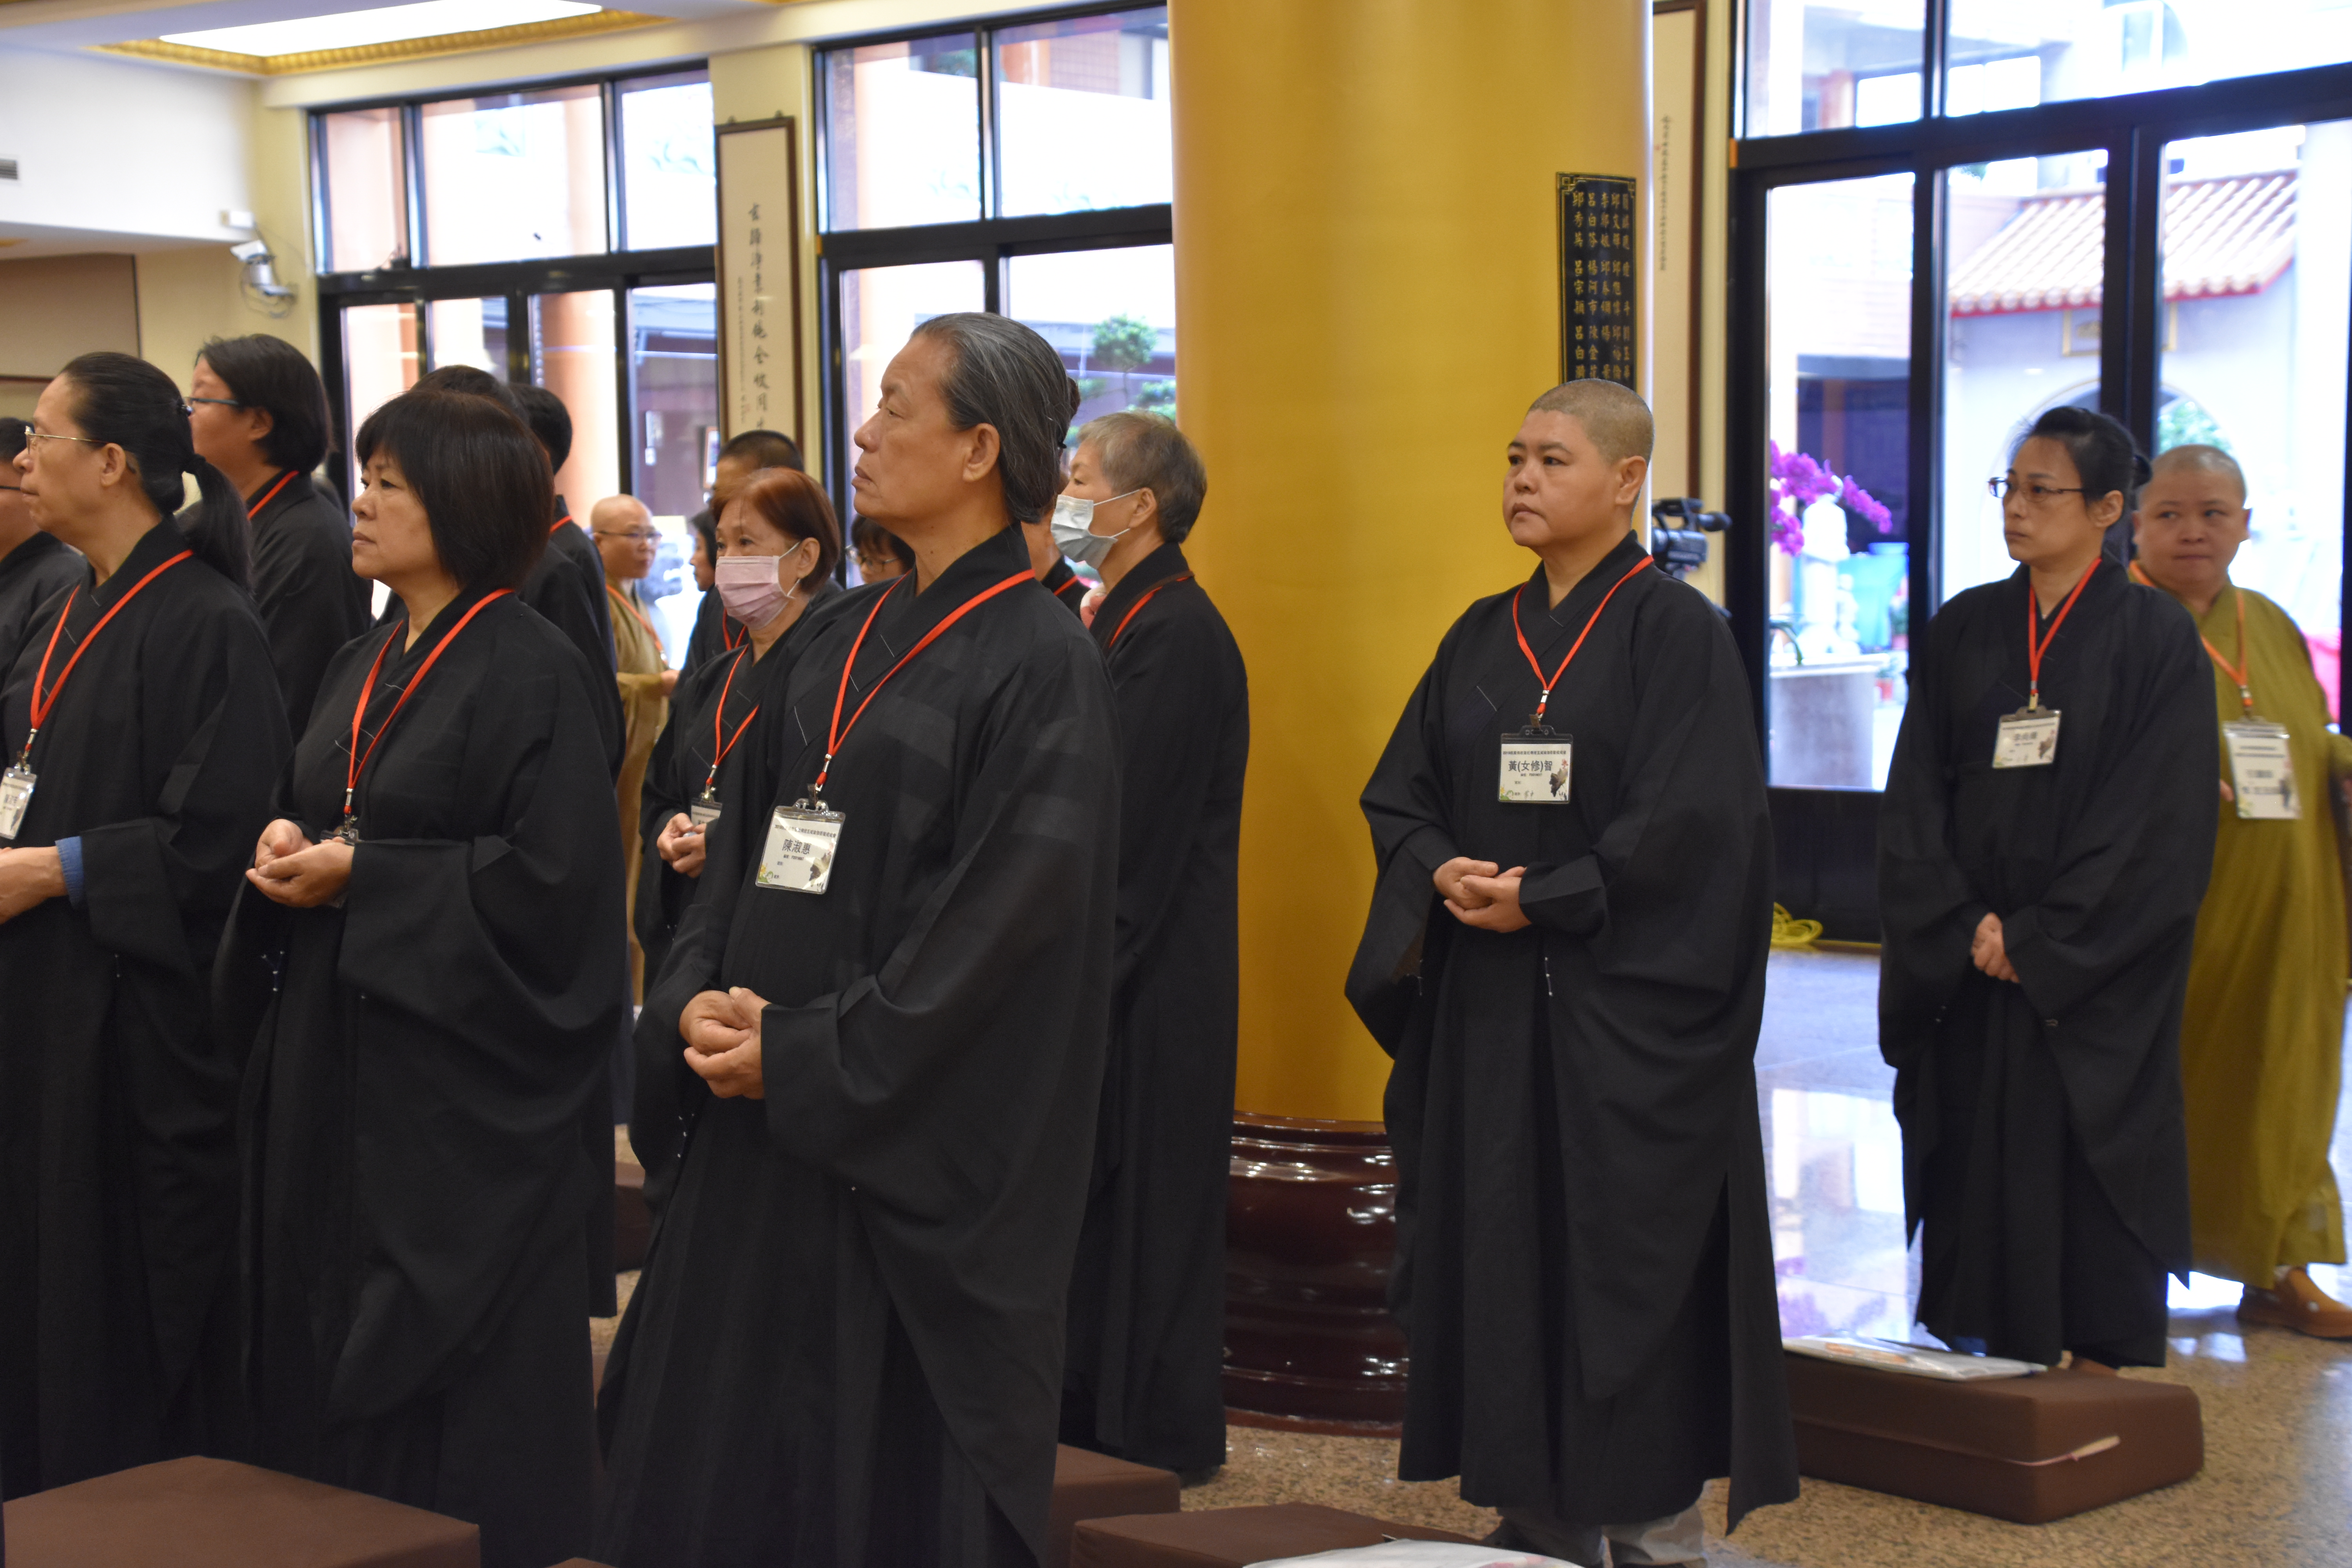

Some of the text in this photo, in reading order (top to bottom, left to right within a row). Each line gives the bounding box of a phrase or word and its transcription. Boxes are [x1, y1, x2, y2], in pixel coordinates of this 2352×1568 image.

[1508, 760, 1553, 772] 黃(女修)智
[782, 838, 812, 855] 陳淑惠
